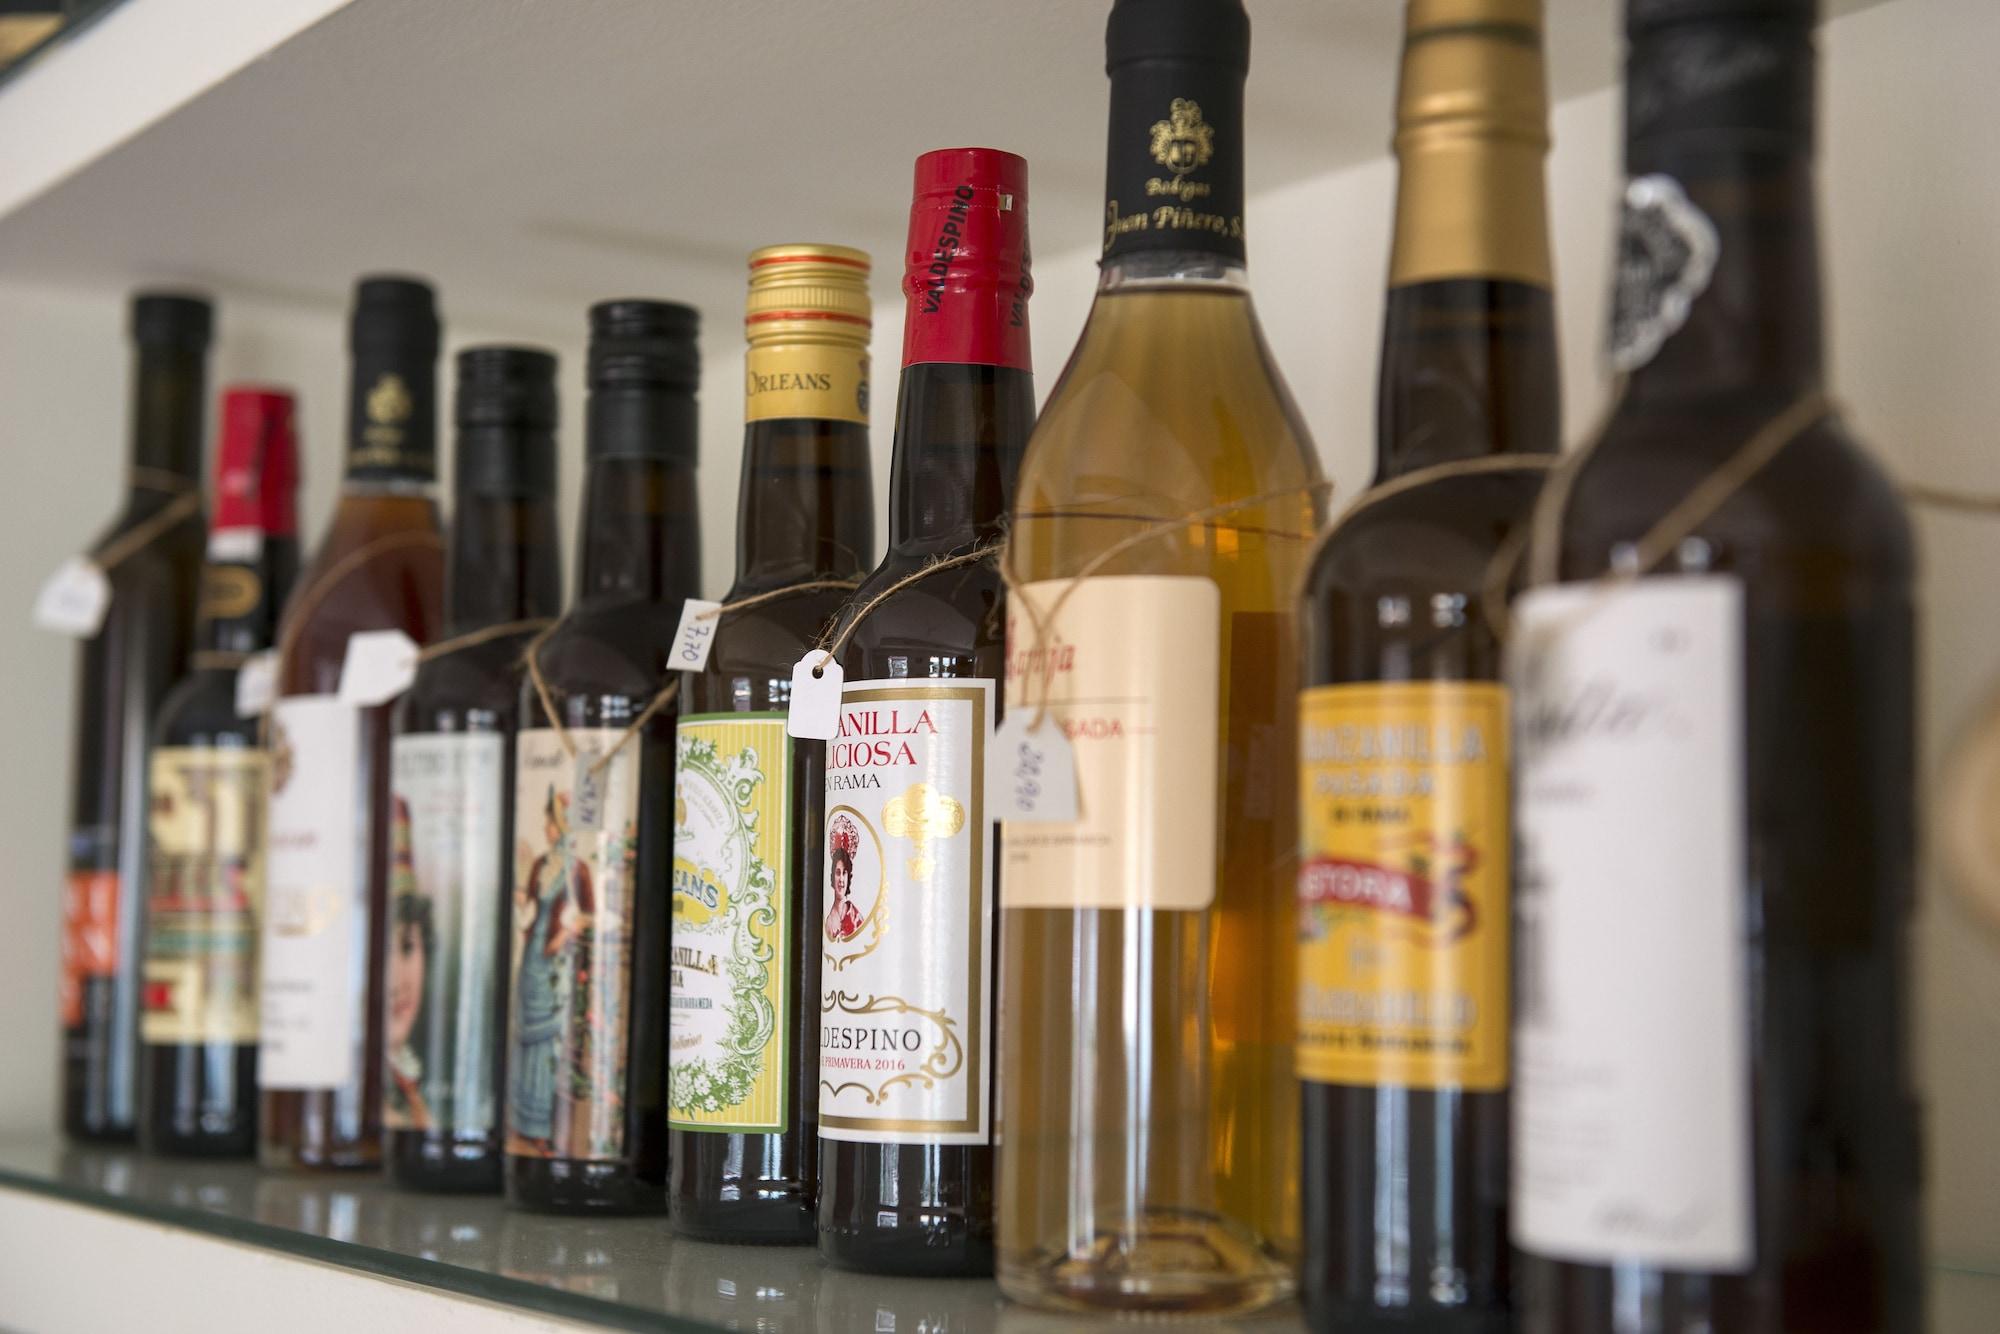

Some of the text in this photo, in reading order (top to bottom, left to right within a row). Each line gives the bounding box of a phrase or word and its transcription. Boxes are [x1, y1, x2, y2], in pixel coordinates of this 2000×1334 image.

[1104, 199, 1149, 252] Juan
[922, 185, 976, 315] VALDESPINO
[837, 709, 939, 737] ANILLA
[1063, 718, 1124, 742] SADA
[826, 741, 917, 771] LICIOSA
[833, 773, 881, 791] RAMA
[671, 946, 720, 977] ANILLA
[820, 1026, 921, 1051] DESPINO
[874, 1059, 905, 1071] 2016
